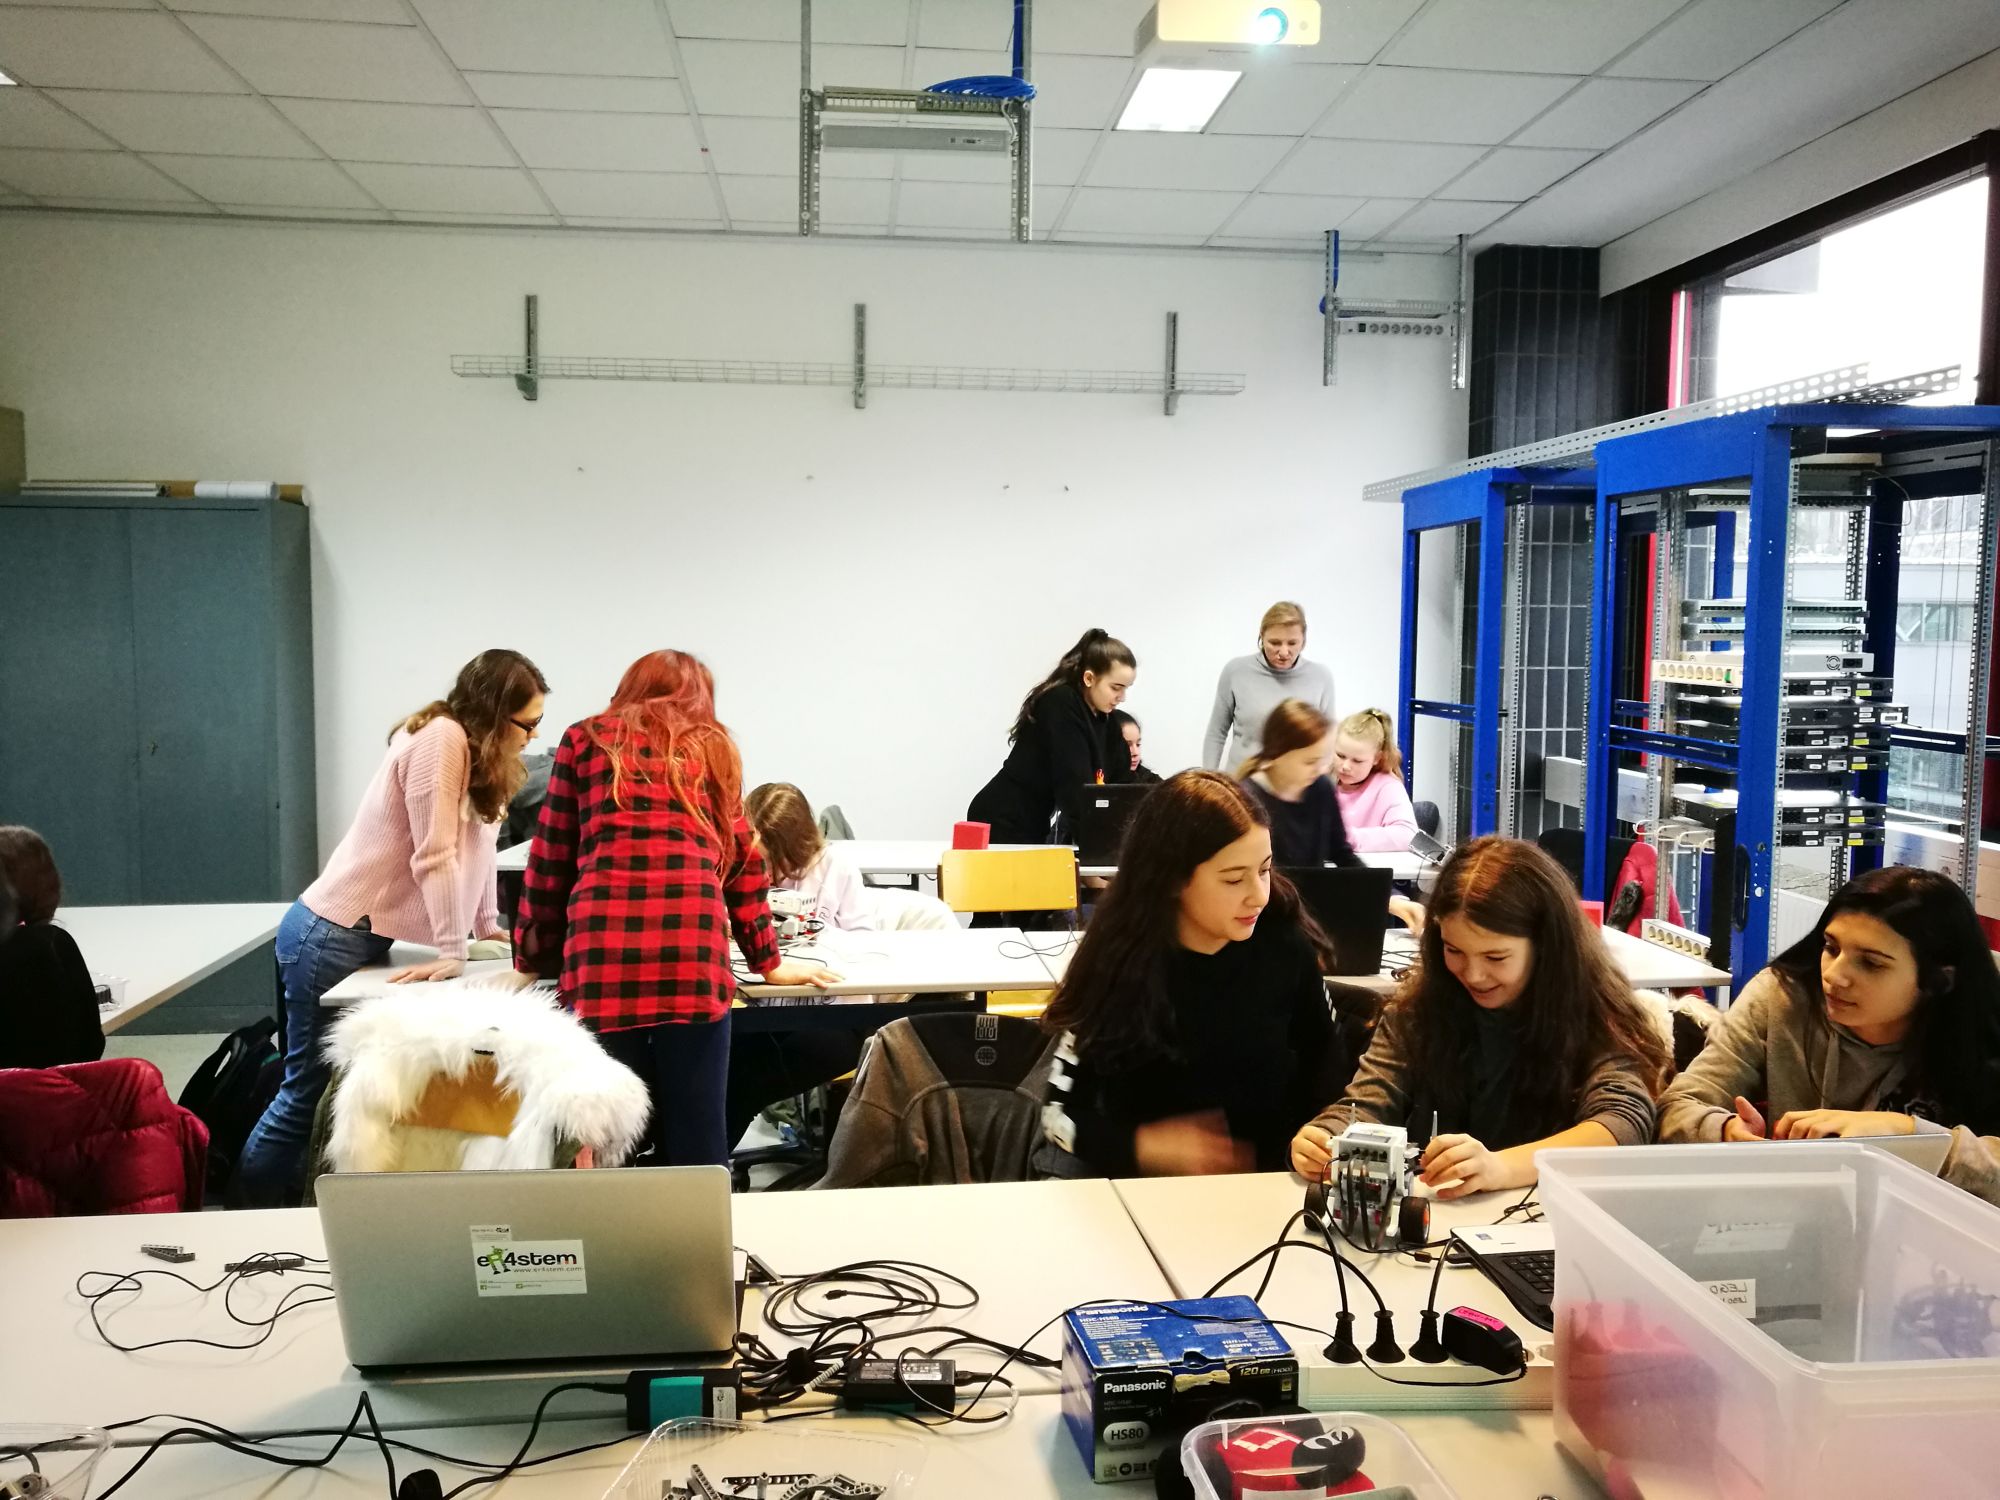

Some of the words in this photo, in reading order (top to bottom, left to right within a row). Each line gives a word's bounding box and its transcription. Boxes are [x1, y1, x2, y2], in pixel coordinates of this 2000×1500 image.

[1075, 1305, 1149, 1316] Panasonic
[1240, 1366, 1259, 1377] 120
[1103, 1379, 1167, 1394] Panasonic
[1111, 1427, 1144, 1441] HS80
